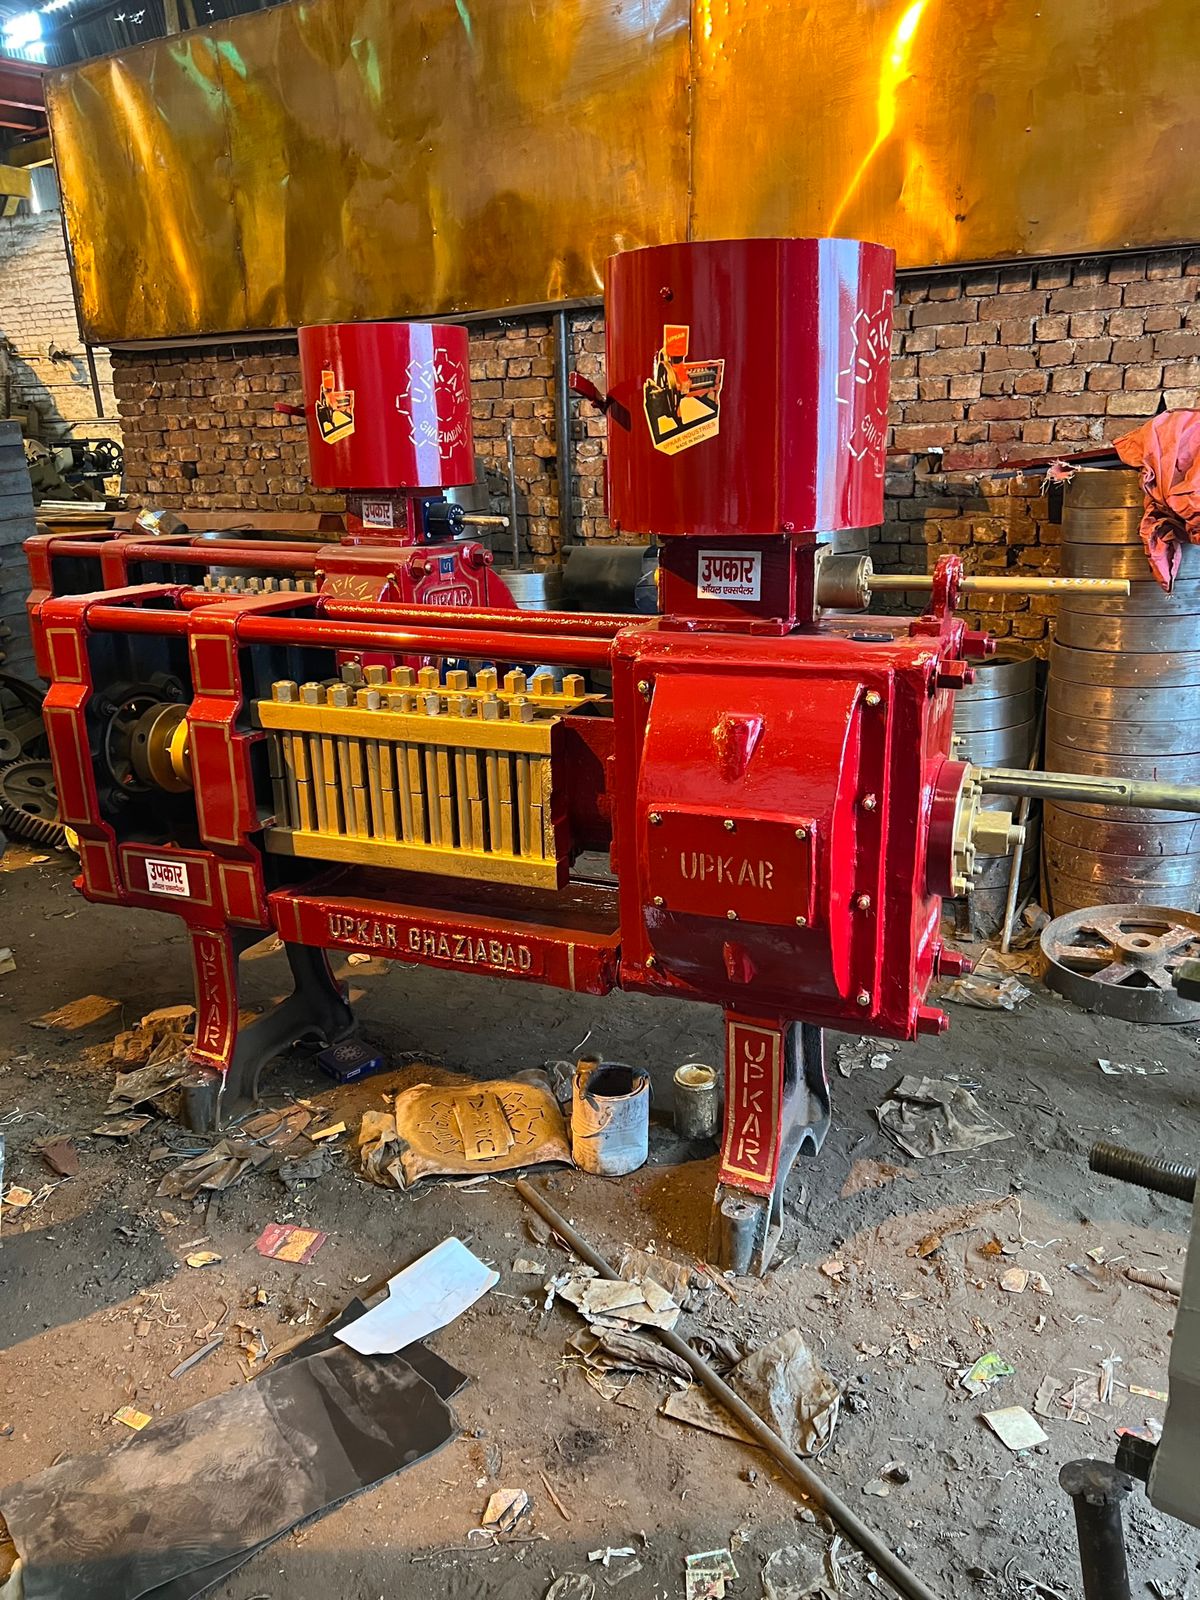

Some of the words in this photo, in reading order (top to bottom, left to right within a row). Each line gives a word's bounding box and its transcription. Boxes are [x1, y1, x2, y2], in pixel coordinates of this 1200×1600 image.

[682, 421, 715, 439] INDUSTRIES
[702, 556, 755, 584] उपकार
[148, 861, 183, 885] उपकार
[680, 851, 774, 890] UPKAR
[328, 913, 398, 948] UPKAR
[408, 927, 532, 970] GHAZIABAD
[200, 942, 221, 1047] UPKAR
[737, 1039, 767, 1166] UPKAR
